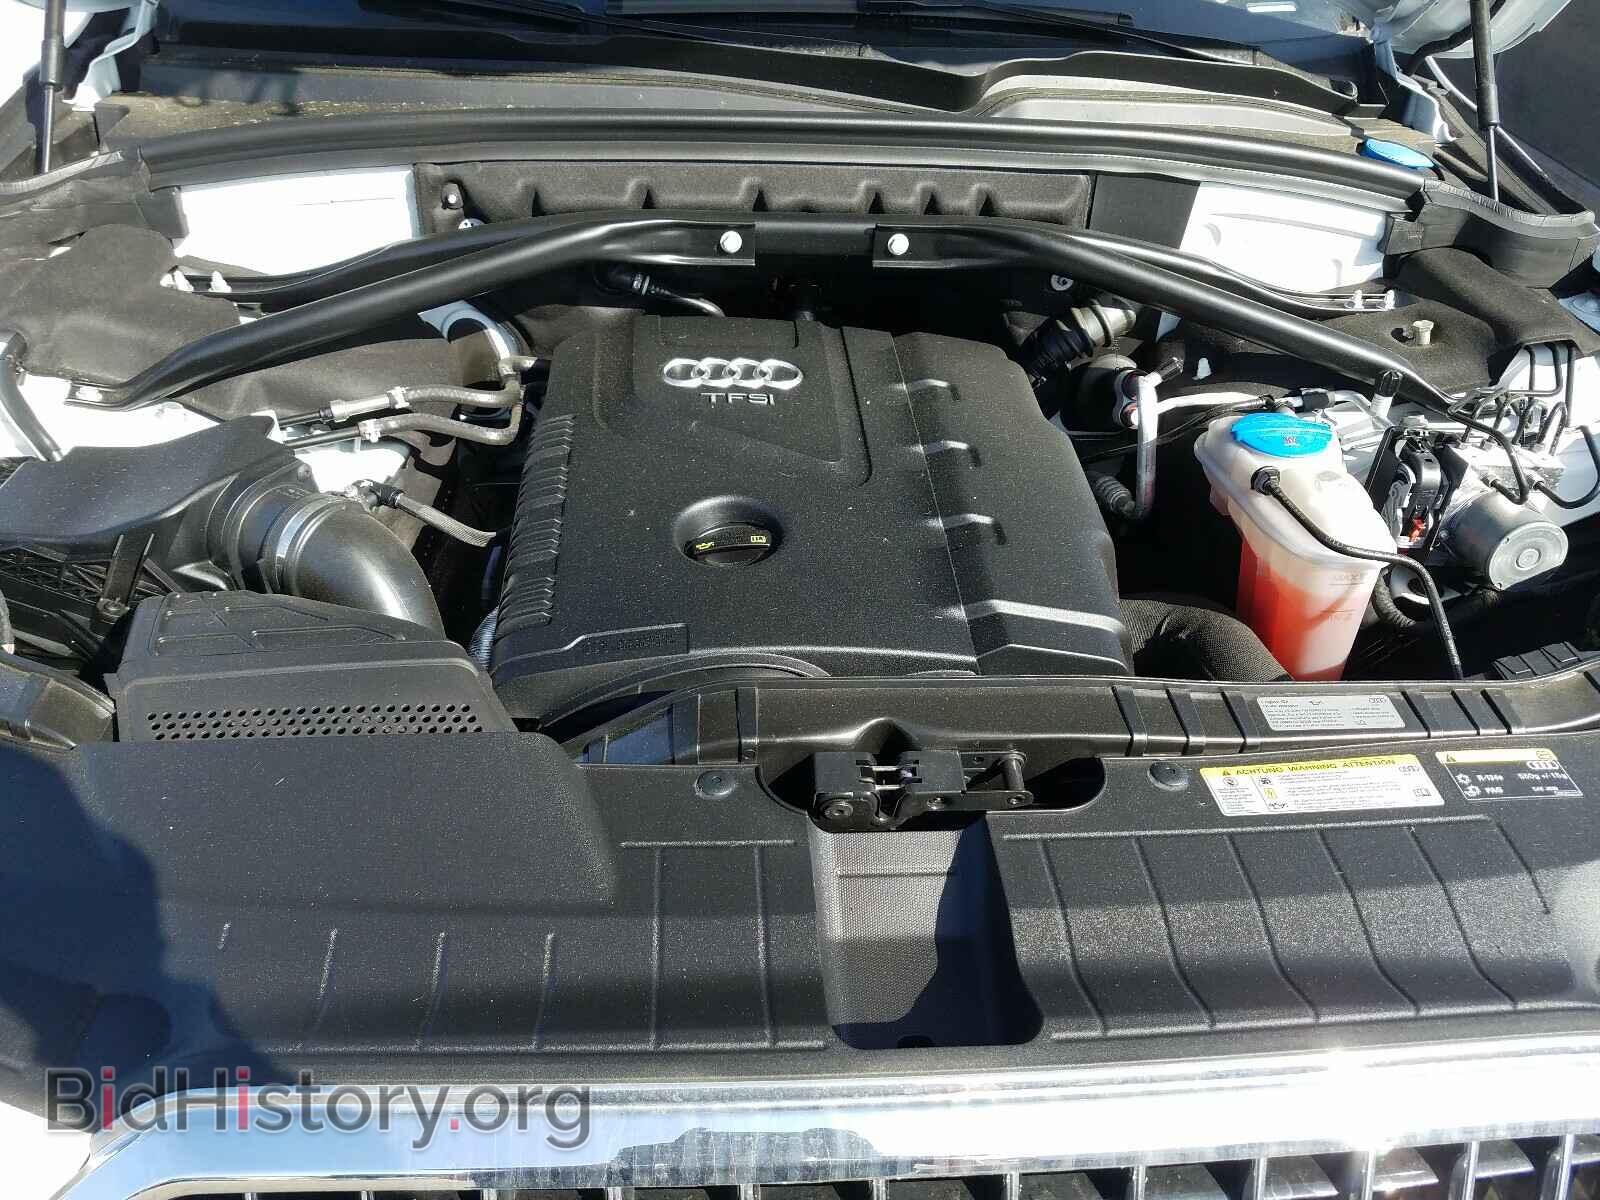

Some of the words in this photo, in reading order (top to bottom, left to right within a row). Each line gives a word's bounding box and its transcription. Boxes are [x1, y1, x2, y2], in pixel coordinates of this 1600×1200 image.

[700, 392, 776, 406] TFSI
[1235, 765, 1284, 776] ACHTUNG
[1287, 762, 1337, 773] WARNING
[1342, 758, 1397, 769] ATTENTION
